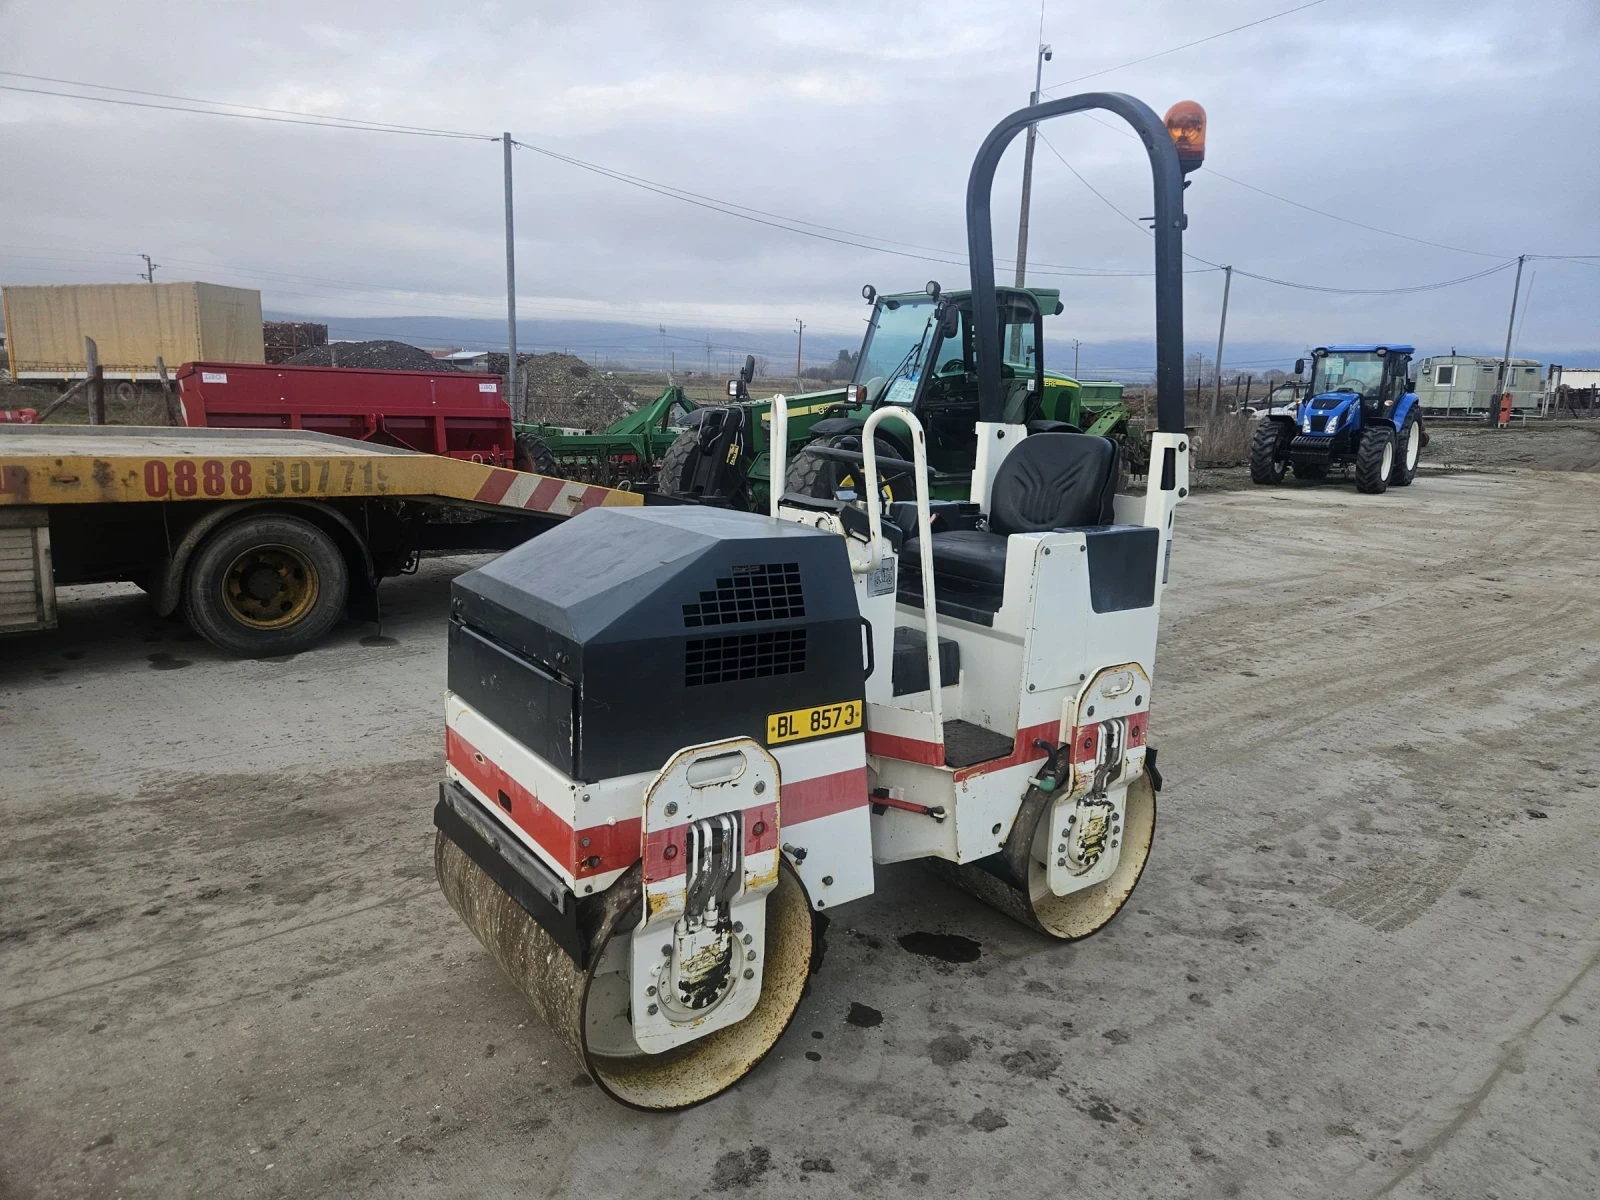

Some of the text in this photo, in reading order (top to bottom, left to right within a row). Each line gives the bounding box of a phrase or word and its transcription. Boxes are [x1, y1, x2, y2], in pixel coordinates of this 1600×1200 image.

[144, 459, 252, 497] 0888
[778, 705, 855, 738] BL 8573
